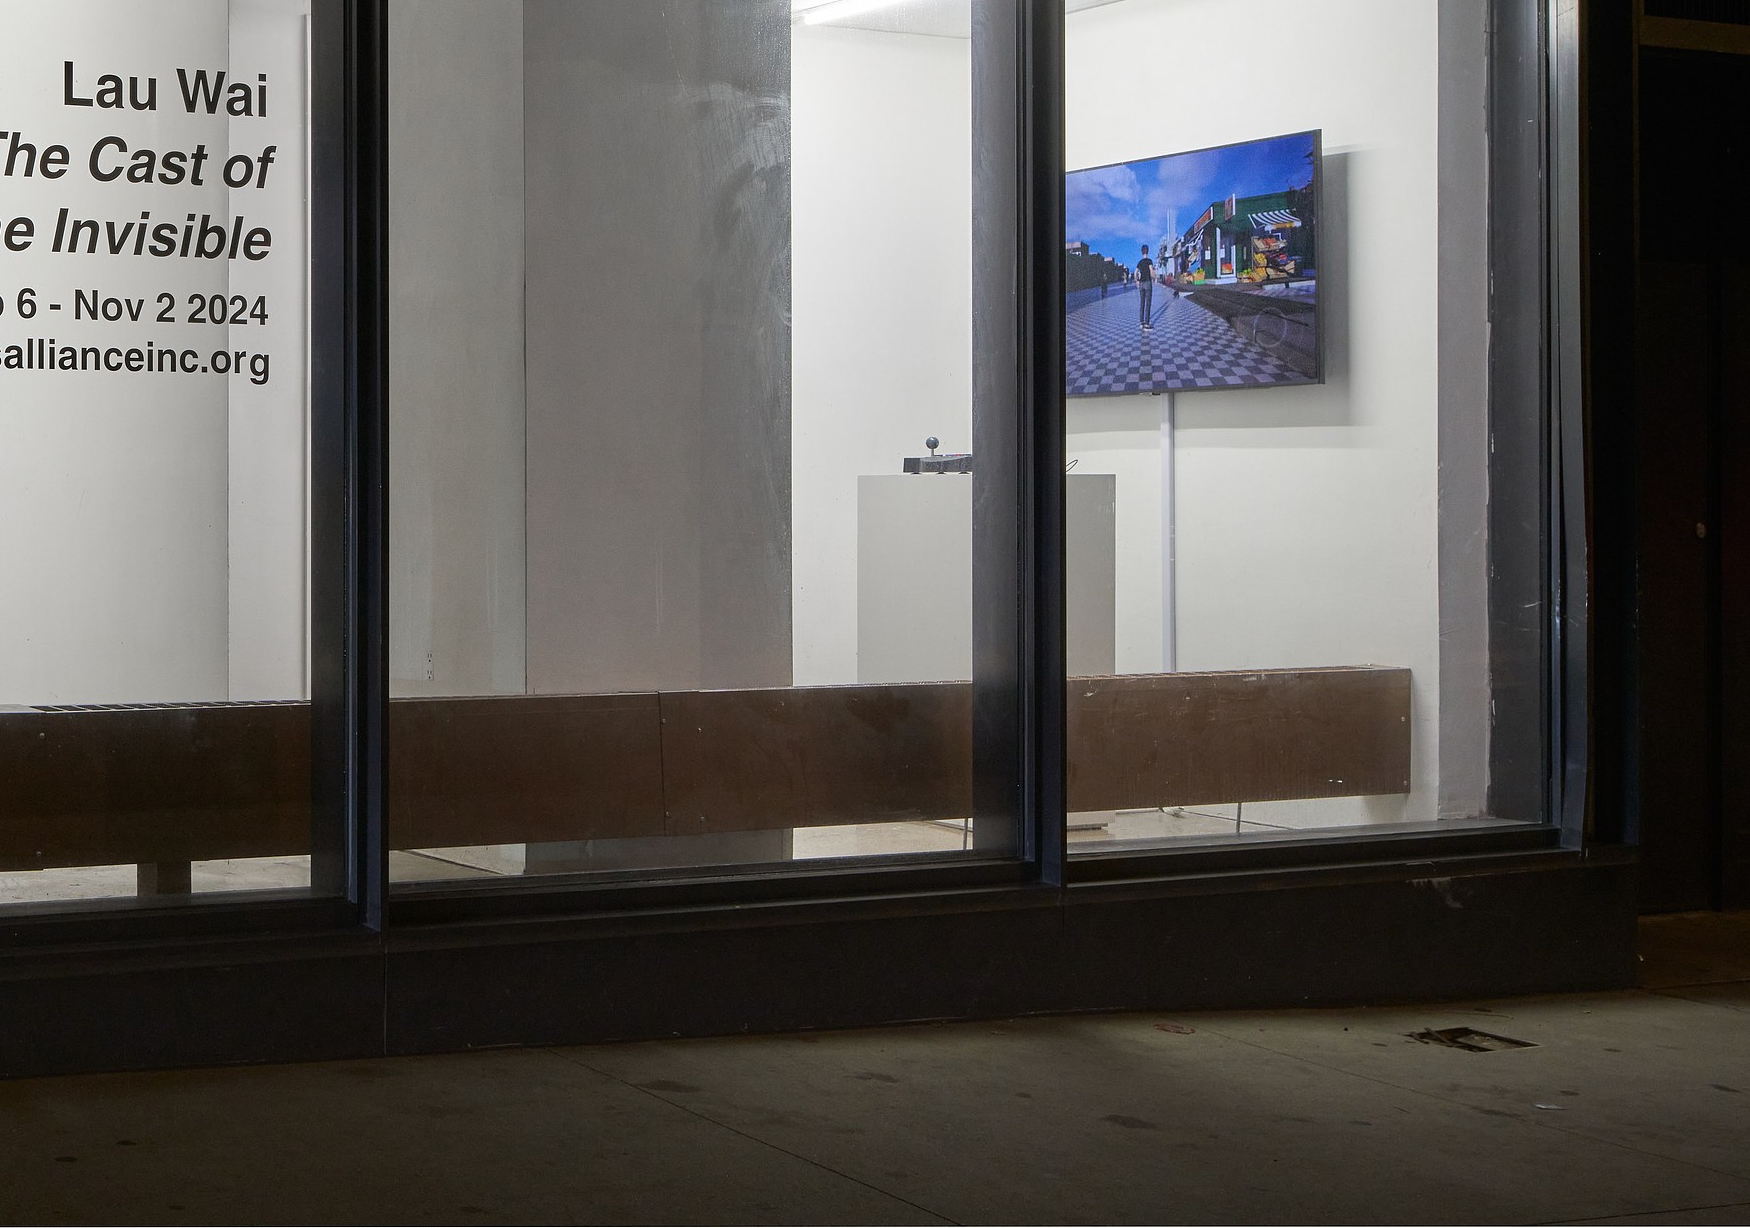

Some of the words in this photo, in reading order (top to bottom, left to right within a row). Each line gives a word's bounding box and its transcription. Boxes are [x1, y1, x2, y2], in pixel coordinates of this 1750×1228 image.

[65, 61, 156, 110] Lau
[177, 69, 266, 117] Wai
[90, 136, 208, 185] Cast
[223, 146, 276, 188] of
[52, 208, 271, 260] Invisible
[18, 288, 36, 318] 6
[75, 290, 144, 321] Nov
[157, 293, 175, 322] 2
[188, 294, 268, 325] 2024
